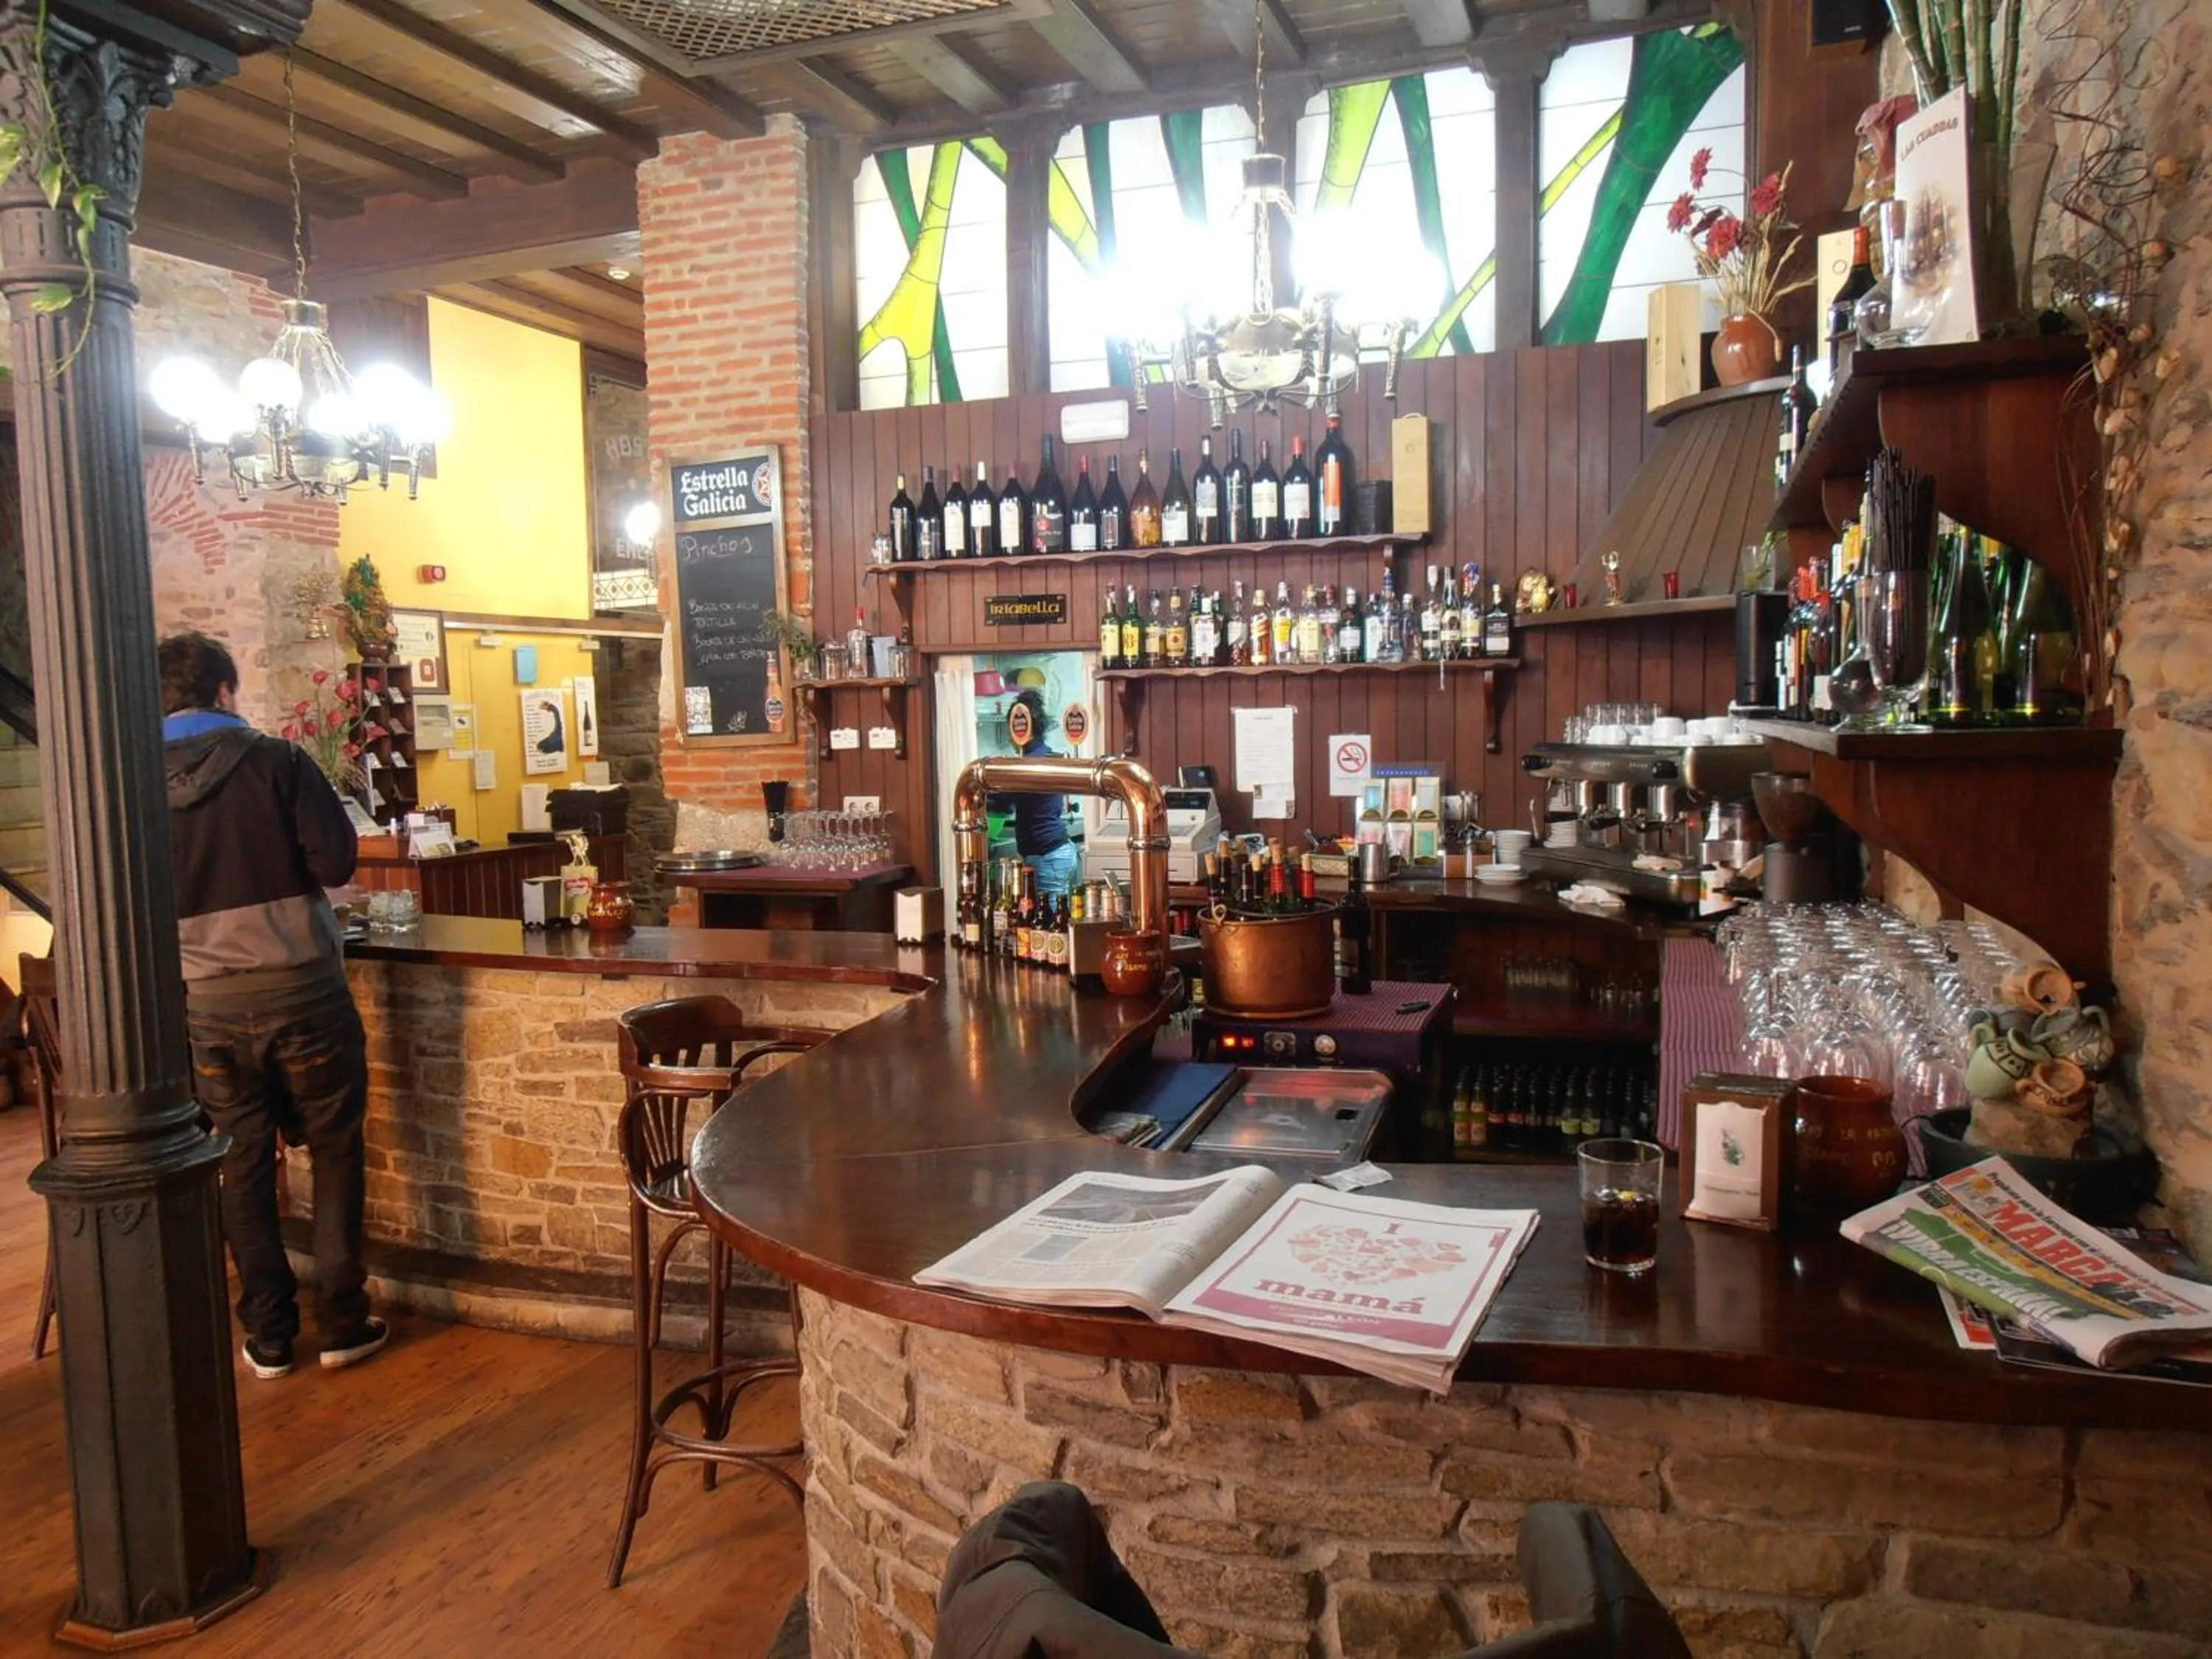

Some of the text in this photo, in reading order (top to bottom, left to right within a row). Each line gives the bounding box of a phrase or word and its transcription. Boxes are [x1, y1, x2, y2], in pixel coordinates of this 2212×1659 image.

[680, 466, 748, 493] Estrella
[684, 489, 746, 516] Galicia
[1982, 1199, 2129, 1287] MARCA
[1253, 1279, 1426, 1315] mamá
